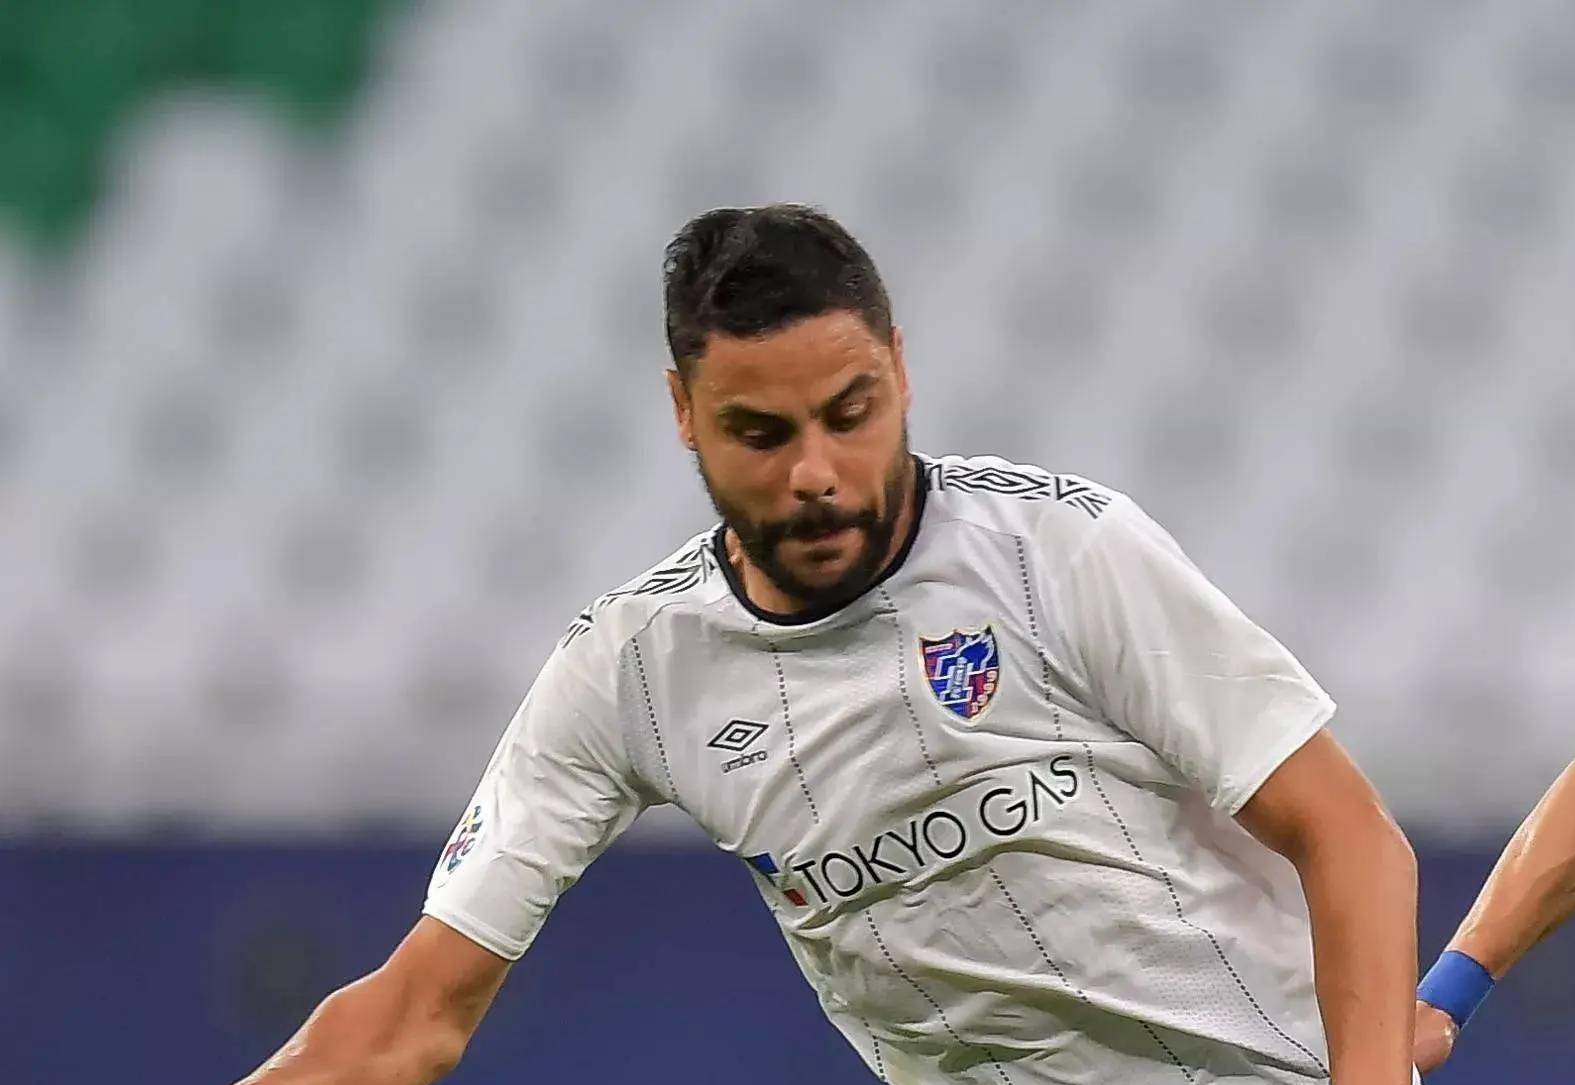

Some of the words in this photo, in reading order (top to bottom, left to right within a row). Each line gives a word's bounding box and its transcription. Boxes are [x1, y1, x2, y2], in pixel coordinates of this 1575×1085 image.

[721, 750, 768, 773] umbro
[793, 811, 966, 903] TOKYO
[979, 755, 1078, 836] GAS
